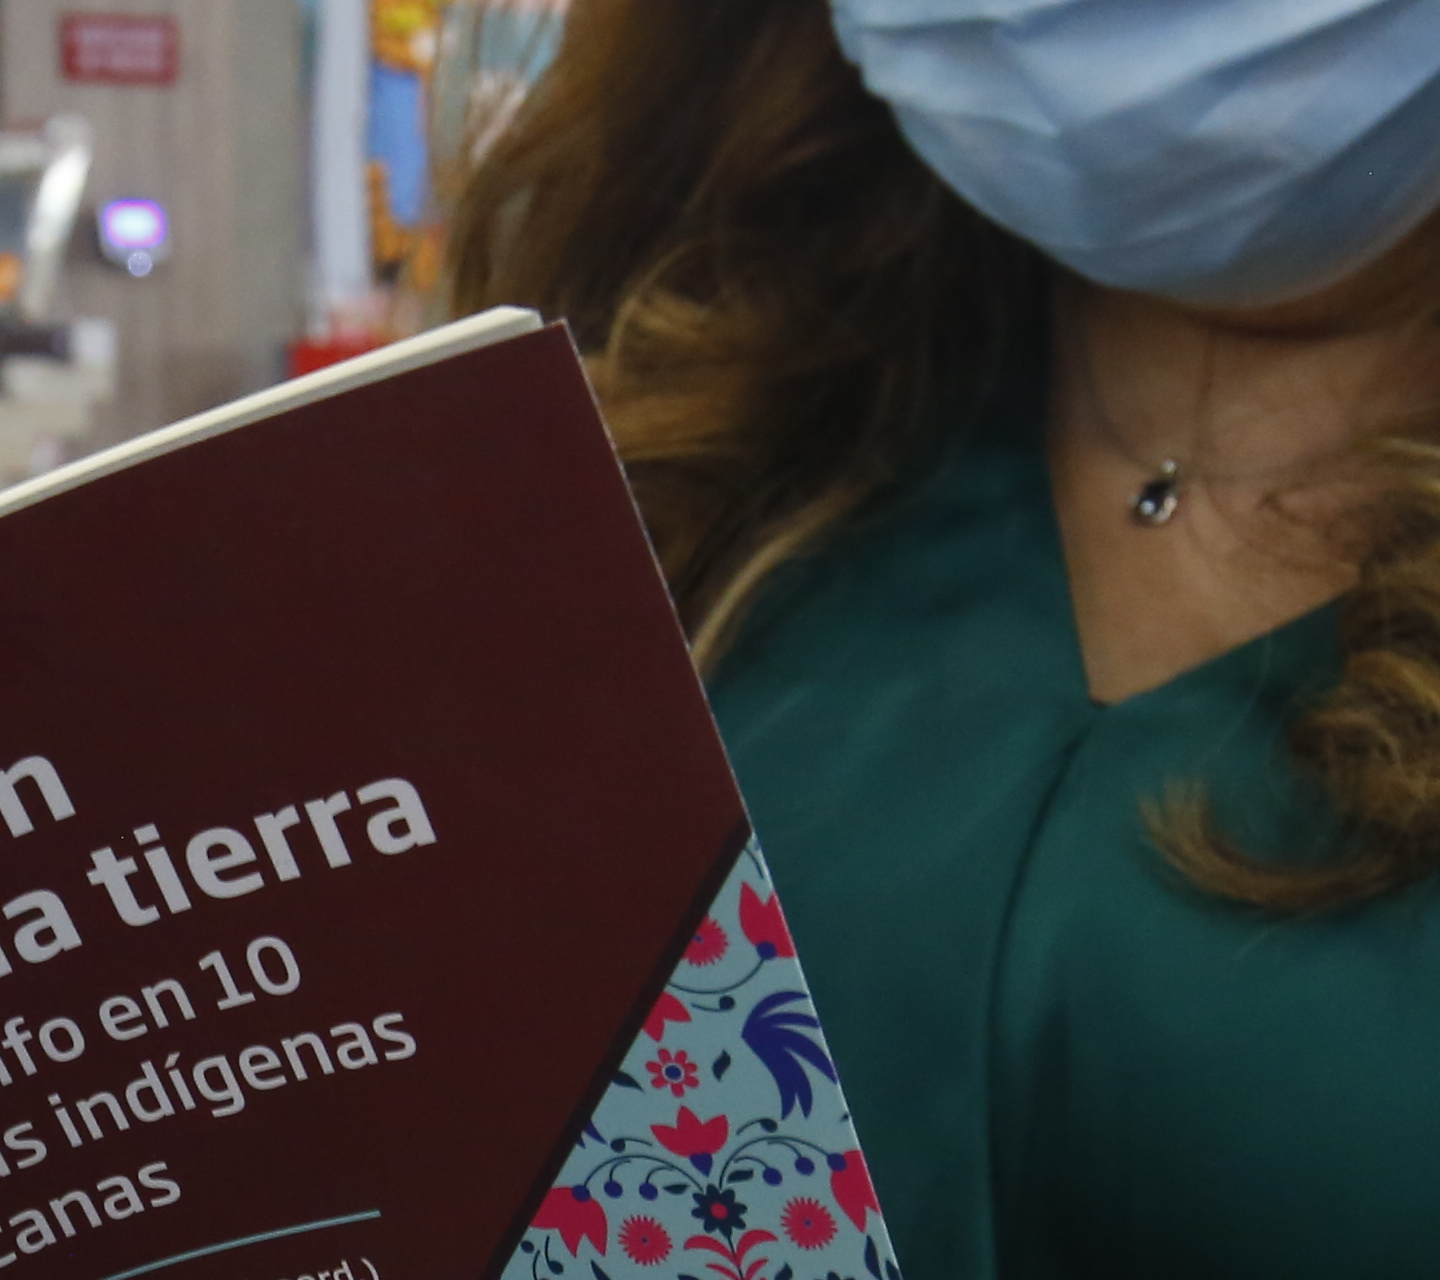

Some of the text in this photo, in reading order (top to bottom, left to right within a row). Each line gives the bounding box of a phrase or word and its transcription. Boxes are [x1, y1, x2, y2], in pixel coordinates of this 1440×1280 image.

[86, 778, 437, 928] tierra
[99, 979, 197, 1040] en
[199, 937, 301, 1010] 10
[48, 1013, 417, 1147] indígenas
